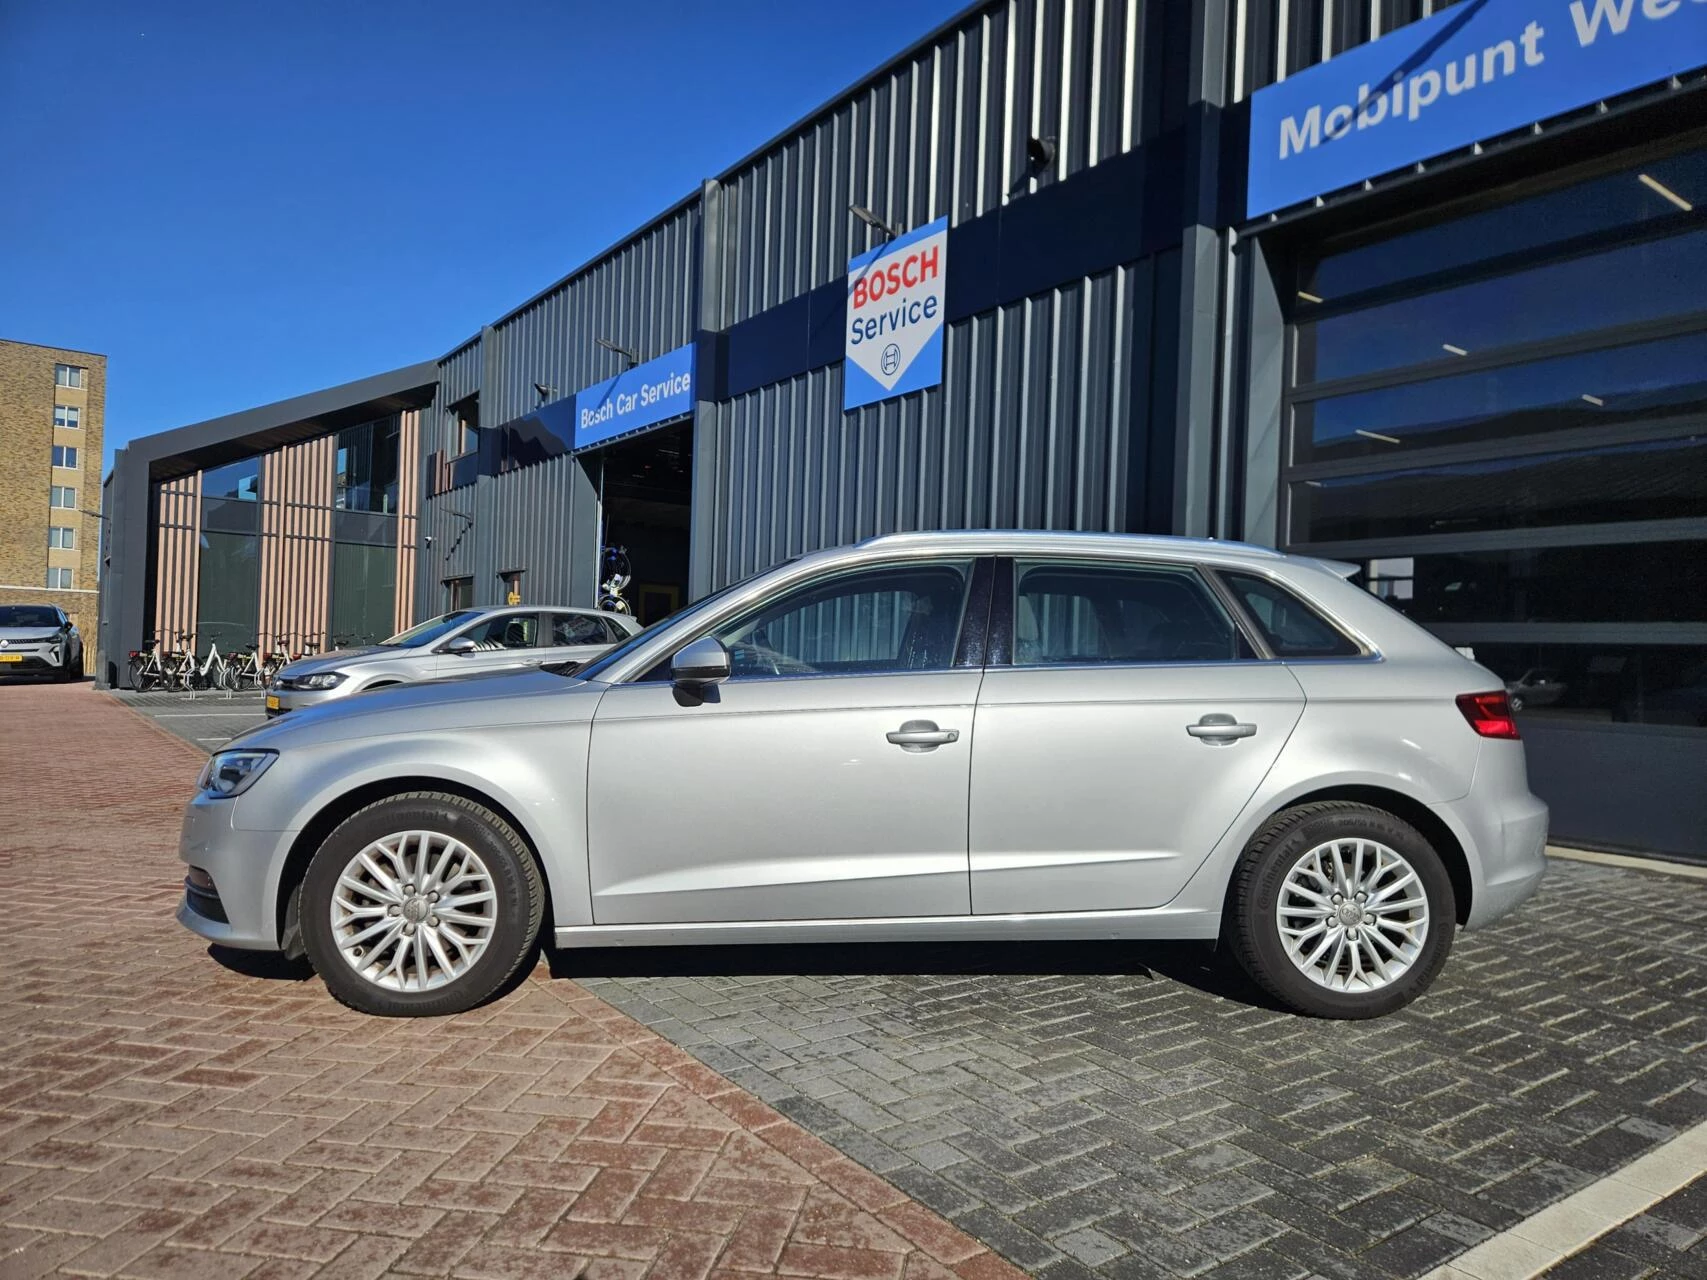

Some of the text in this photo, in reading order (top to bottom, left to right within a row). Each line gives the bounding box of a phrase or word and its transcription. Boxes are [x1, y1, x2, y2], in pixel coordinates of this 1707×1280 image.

[1278, 20, 1546, 161] Mobipunt
[853, 245, 939, 310] BOSCH
[851, 295, 938, 345] Service
[581, 372, 691, 429] Bosch Car Service
